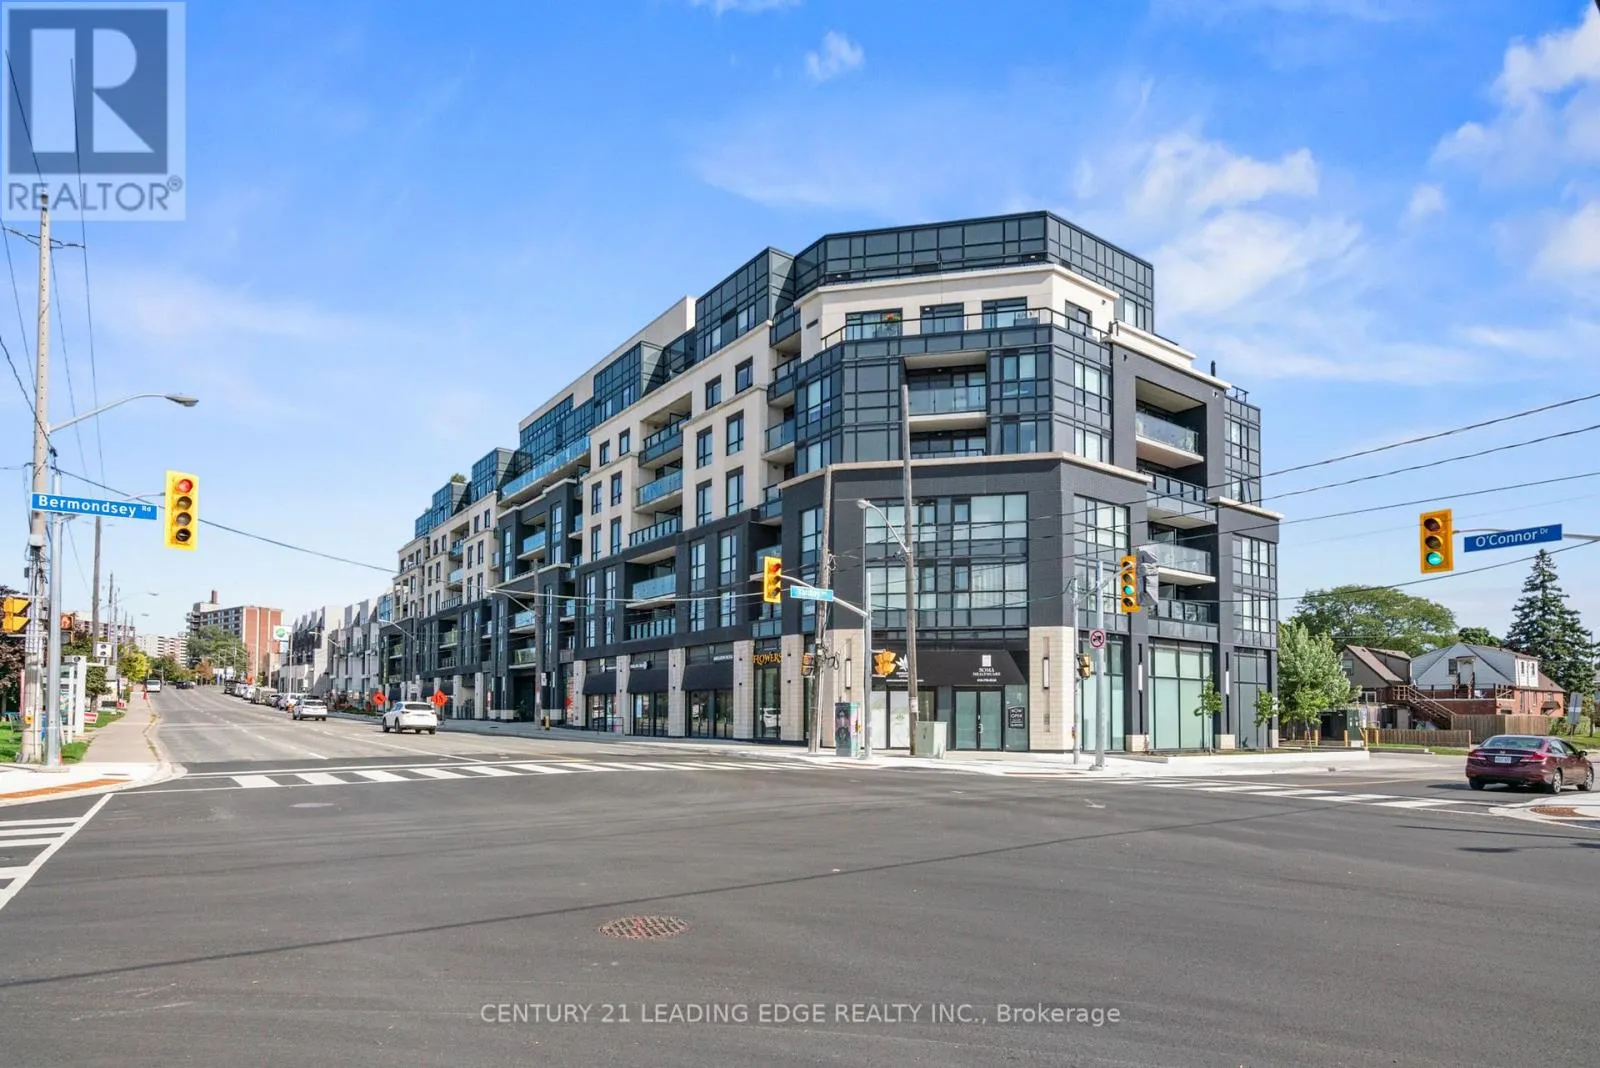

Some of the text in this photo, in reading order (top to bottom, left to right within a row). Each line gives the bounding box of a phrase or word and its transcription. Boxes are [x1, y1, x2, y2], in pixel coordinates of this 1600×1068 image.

[38, 495, 151, 518] Bermondsey Rd
[1476, 527, 1549, 547] O'Connor Dr
